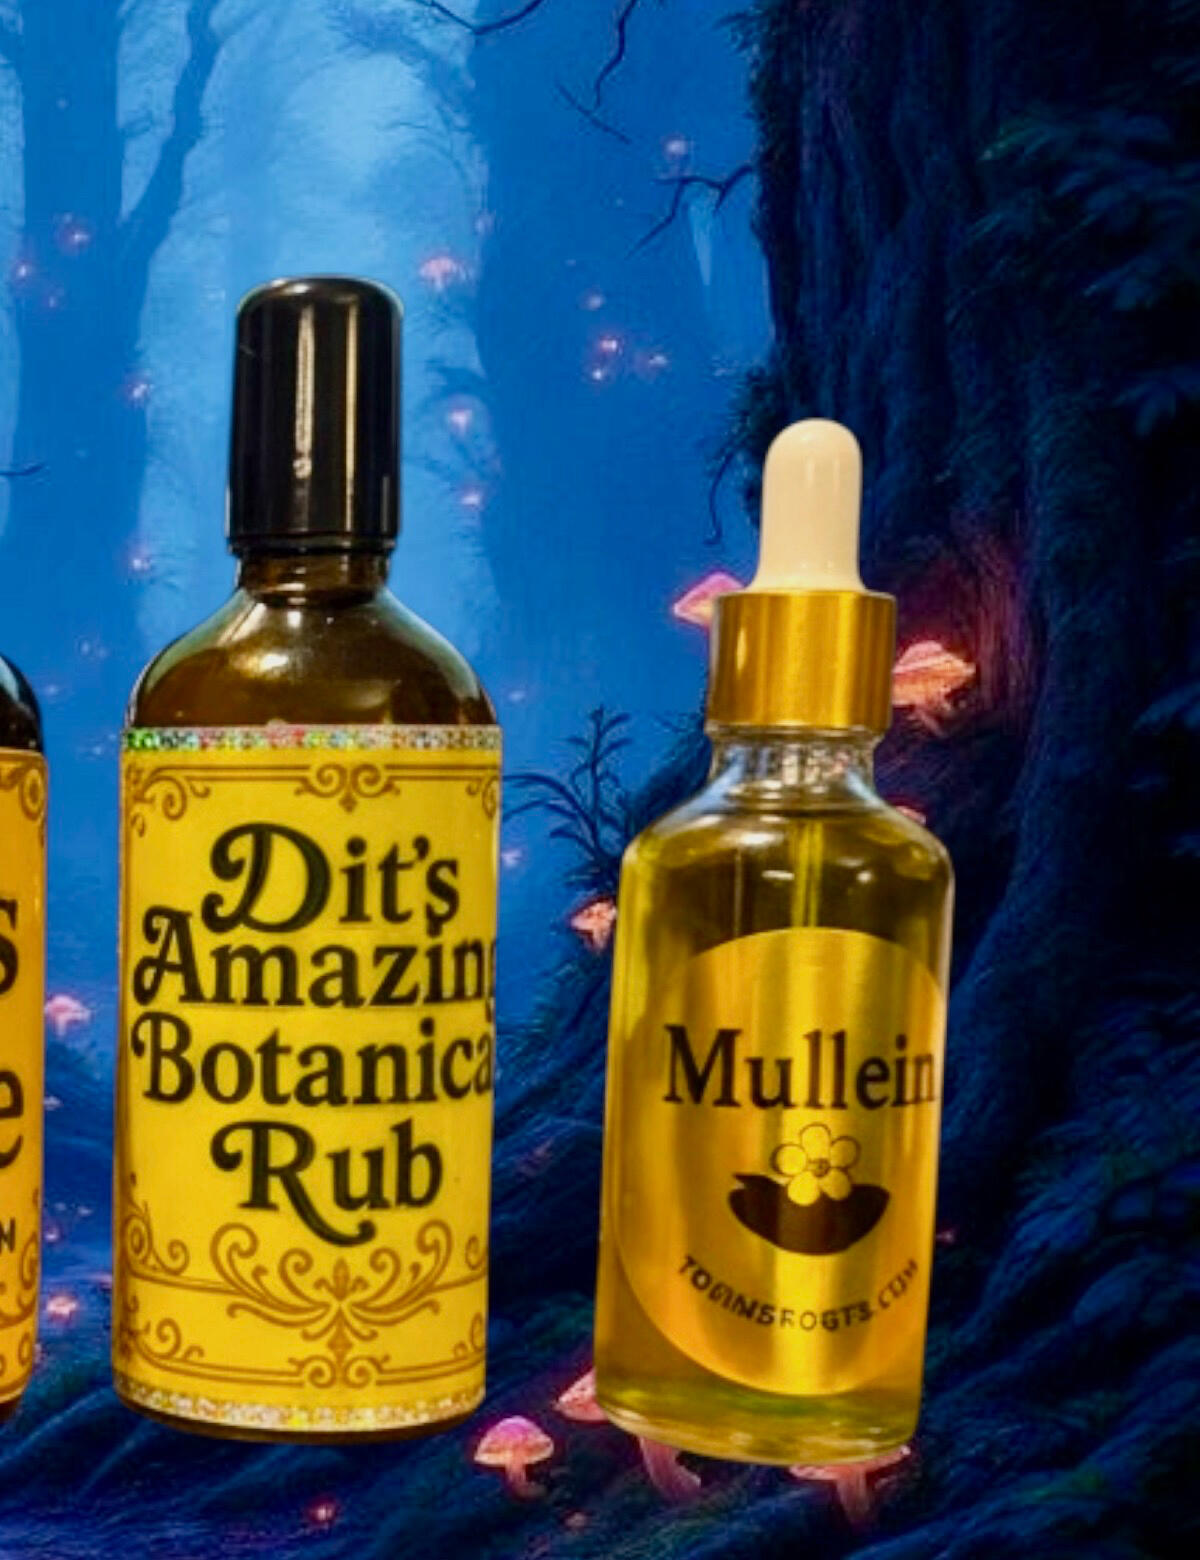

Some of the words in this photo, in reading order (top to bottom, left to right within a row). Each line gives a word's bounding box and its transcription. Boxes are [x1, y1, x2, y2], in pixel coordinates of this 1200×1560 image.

[201, 822, 460, 933] Dit's
[132, 905, 496, 1012] Amazin
[663, 1024, 936, 1110] Mullein
[211, 1118, 443, 1247] Rub
